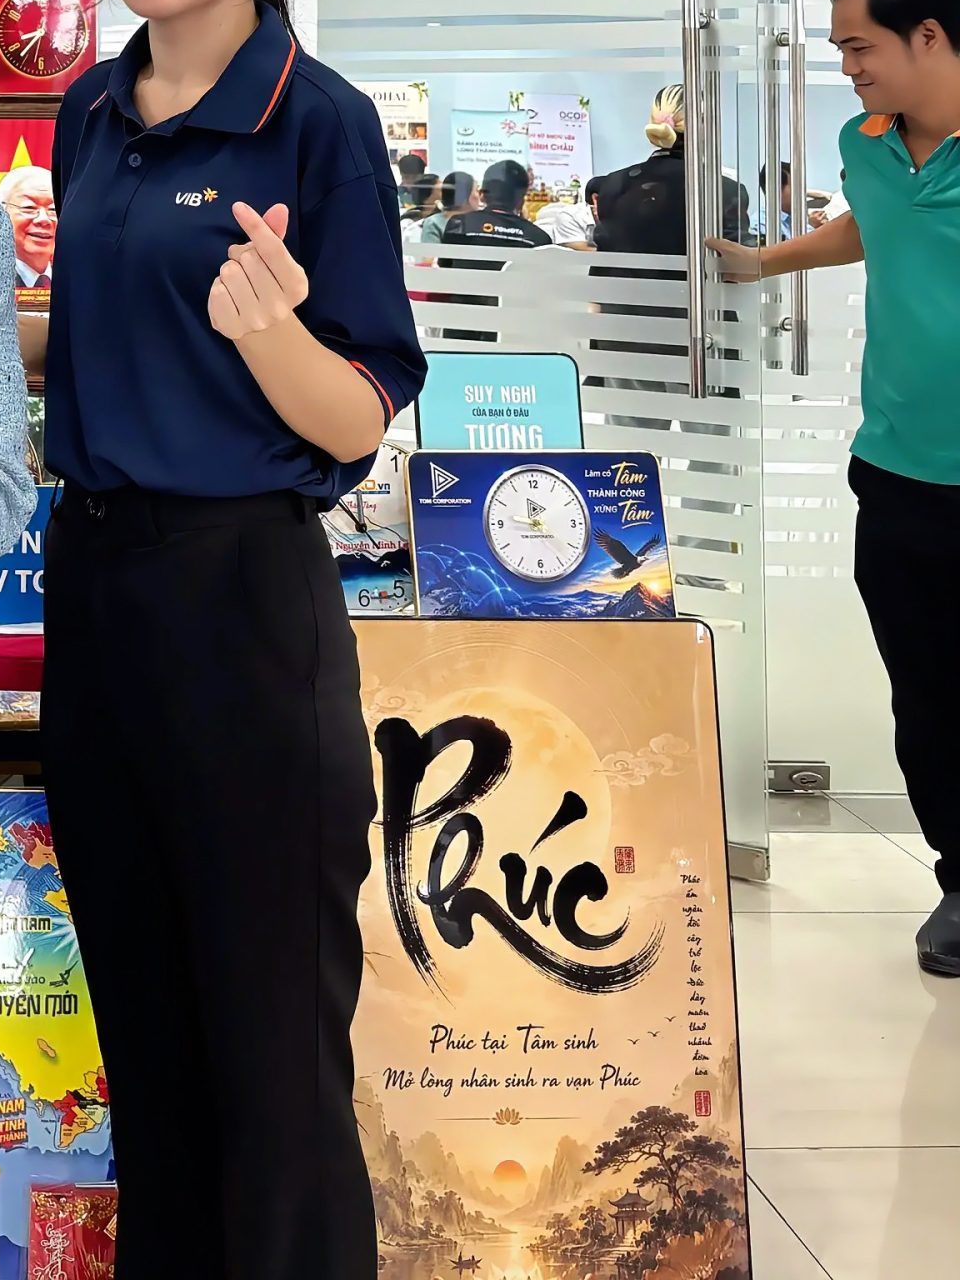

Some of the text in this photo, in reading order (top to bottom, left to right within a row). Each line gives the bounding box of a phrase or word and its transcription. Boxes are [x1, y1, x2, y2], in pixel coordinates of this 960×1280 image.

[38, 57, 44, 70] 6
[175, 192, 202, 207] VIB
[464, 384, 493, 404] SUY
[390, 455, 398, 473] 1
[584, 461, 648, 487] Làm có Tâm
[528, 480, 538, 489] 12
[587, 487, 645, 497] THÀNH CÔNG
[497, 519, 504, 529] 9
[570, 519, 577, 529] 3
[537, 559, 543, 568] 6
[358, 589, 370, 607] 6
[393, 580, 405, 598] 5
[371, 715, 666, 1009] Phúc
[430, 1023, 599, 1054] Phúc tại Tâm sinh
[383, 1063, 641, 1098] Mở lòng nhân sinh ra vạn Phúc
